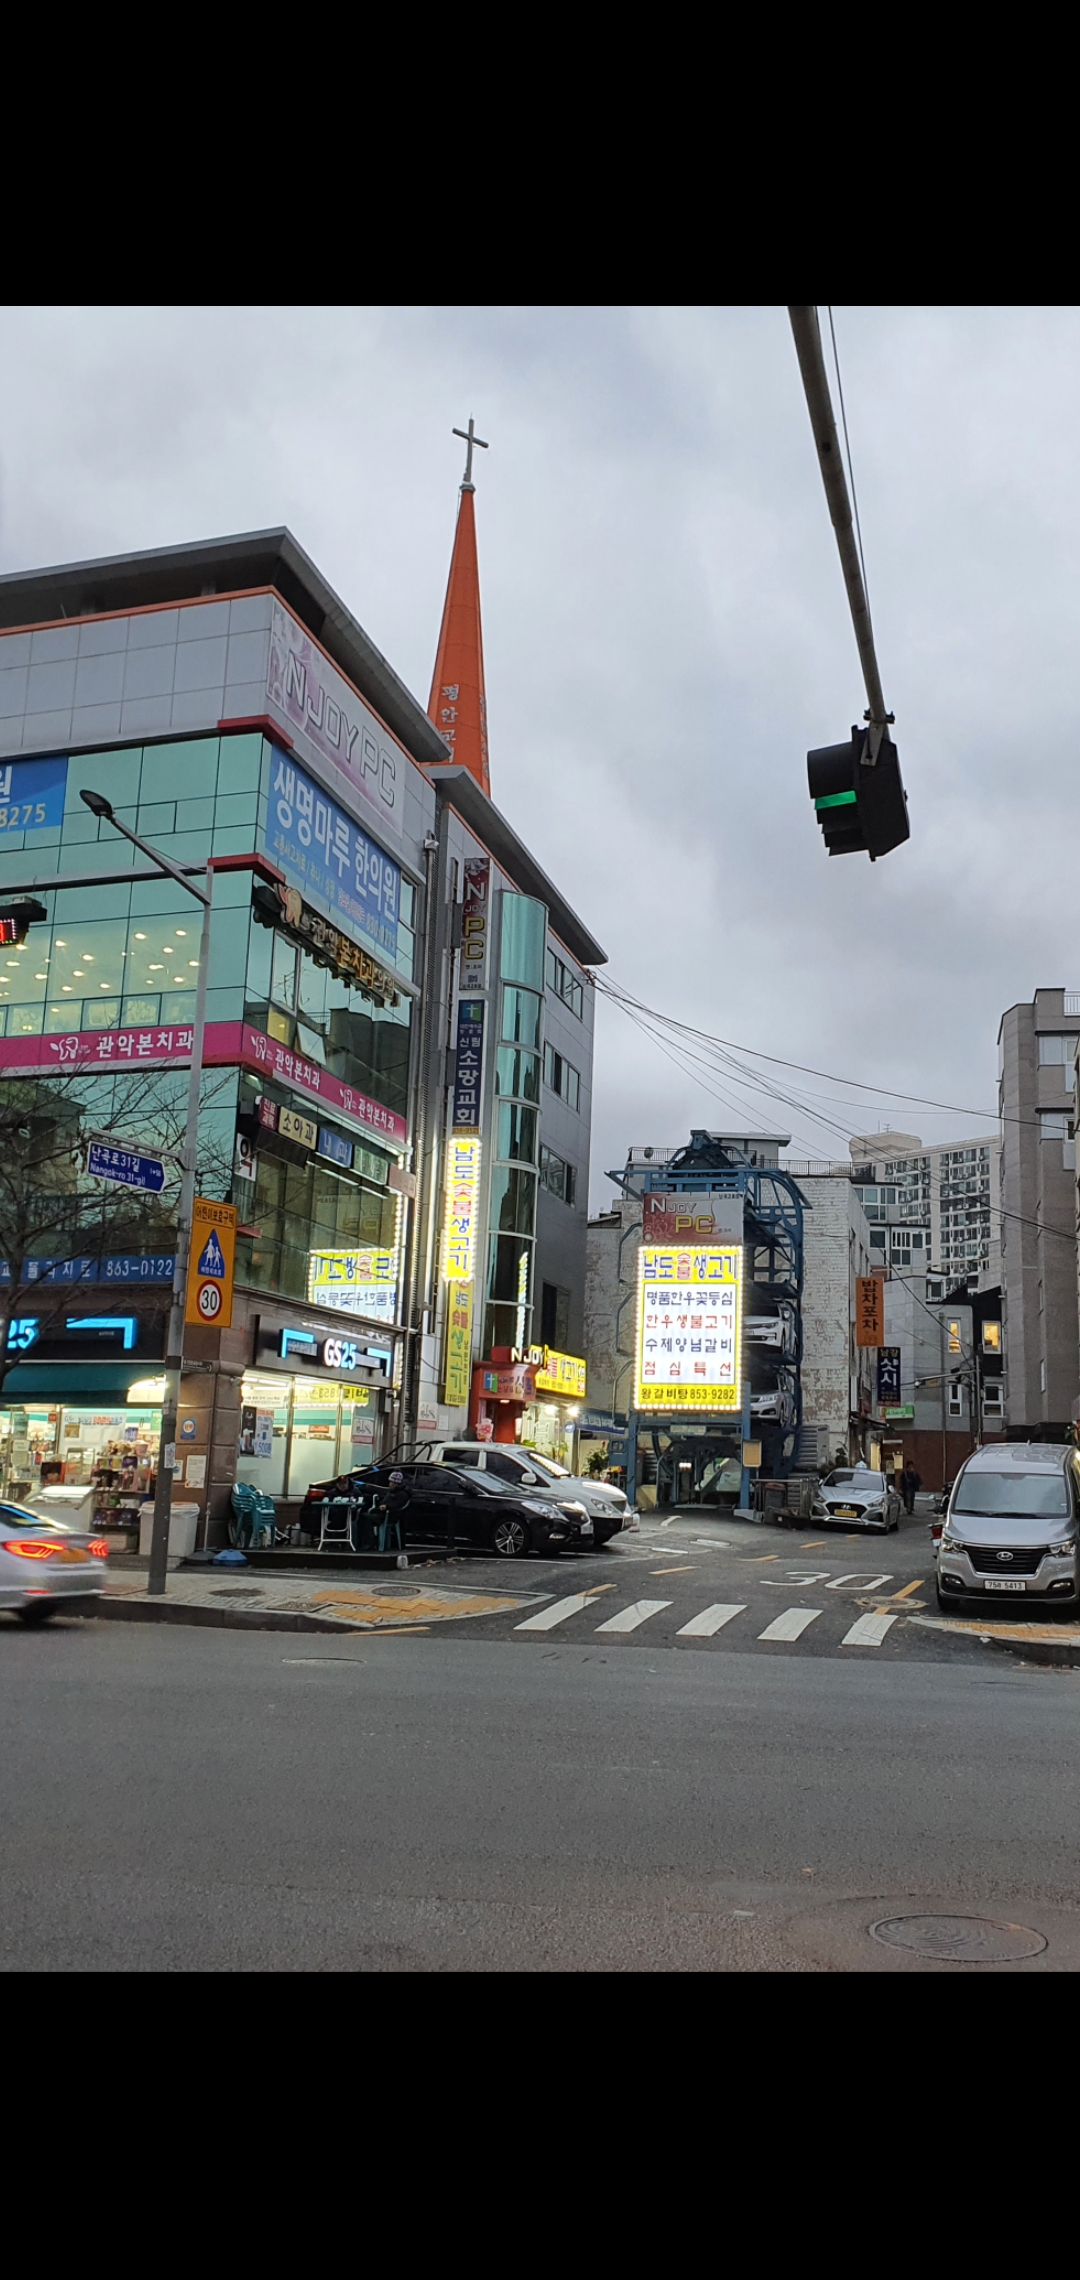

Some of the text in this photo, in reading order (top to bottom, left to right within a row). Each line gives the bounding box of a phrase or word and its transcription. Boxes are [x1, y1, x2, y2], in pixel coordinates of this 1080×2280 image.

[286, 650, 396, 808] NJOY PC
[273, 761, 397, 924] 생명마루 한의원
[96, 1031, 194, 1058] 관악본치과
[459, 1037, 481, 1048] 신림
[275, 1049, 321, 1091] 관악본치과
[456, 1050, 479, 1125] 소망교회
[358, 1098, 395, 1133] 관악본치과
[283, 1113, 315, 1144] 소아과
[91, 1145, 140, 1173] 난곡로31길
[90, 1162, 146, 1186] Nangok-ro 31-gil
[196, 1205, 235, 1224] 어린이보호구역
[675, 1215, 713, 1234] PC
[644, 1252, 737, 1280] 남도숯불생고기
[201, 1289, 218, 1311] 30
[646, 1291, 733, 1306] 명품한우꽃등심
[646, 1314, 732, 1329] 한우생불고기
[324, 1338, 358, 1370] GS25
[645, 1337, 732, 1353] 수제양념갈비
[641, 1388, 688, 1400] 왕갈비탕
[759, 1571, 894, 1590] 30
